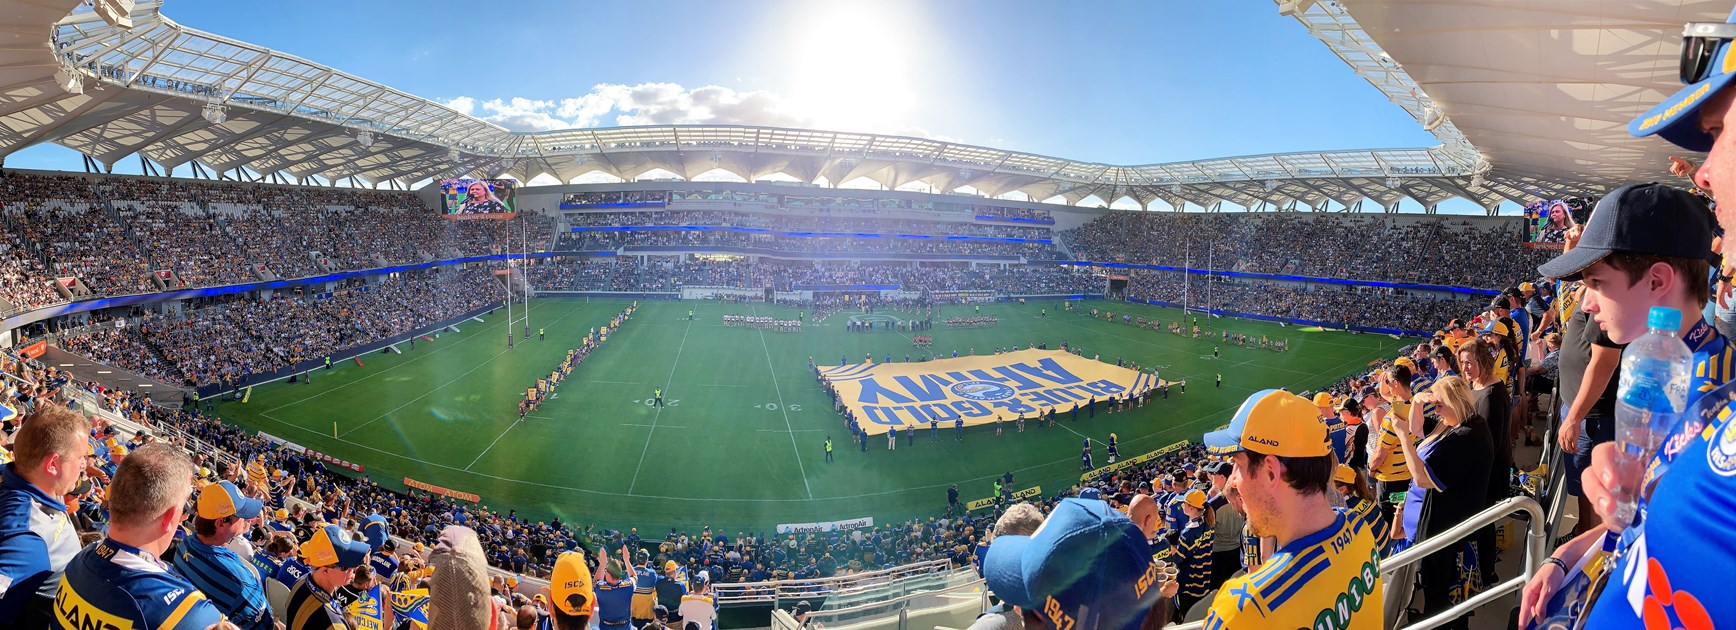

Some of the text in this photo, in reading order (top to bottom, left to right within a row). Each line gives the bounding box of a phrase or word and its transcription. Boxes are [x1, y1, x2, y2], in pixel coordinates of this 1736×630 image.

[857, 357, 1085, 405] ARMY
[861, 379, 1128, 427] BLUE & GOLD
[1167, 441, 1186, 451] ALAND
[1247, 435, 1279, 447] ALAND
[1663, 420, 1704, 461] Kicks
[1145, 449, 1165, 460] ALAND
[1117, 458, 1138, 469] ALAND
[1088, 466, 1112, 479] ALAND
[407, 480, 433, 492] ATOM
[444, 489, 473, 502] ATOM
[1010, 488, 1036, 499] ALAND
[840, 520, 867, 531] ActronAir
[1330, 527, 1352, 554] 1947
[564, 581, 580, 589] ISC
[1317, 552, 1380, 630] UNIBE
[1044, 595, 1075, 630] 1947
